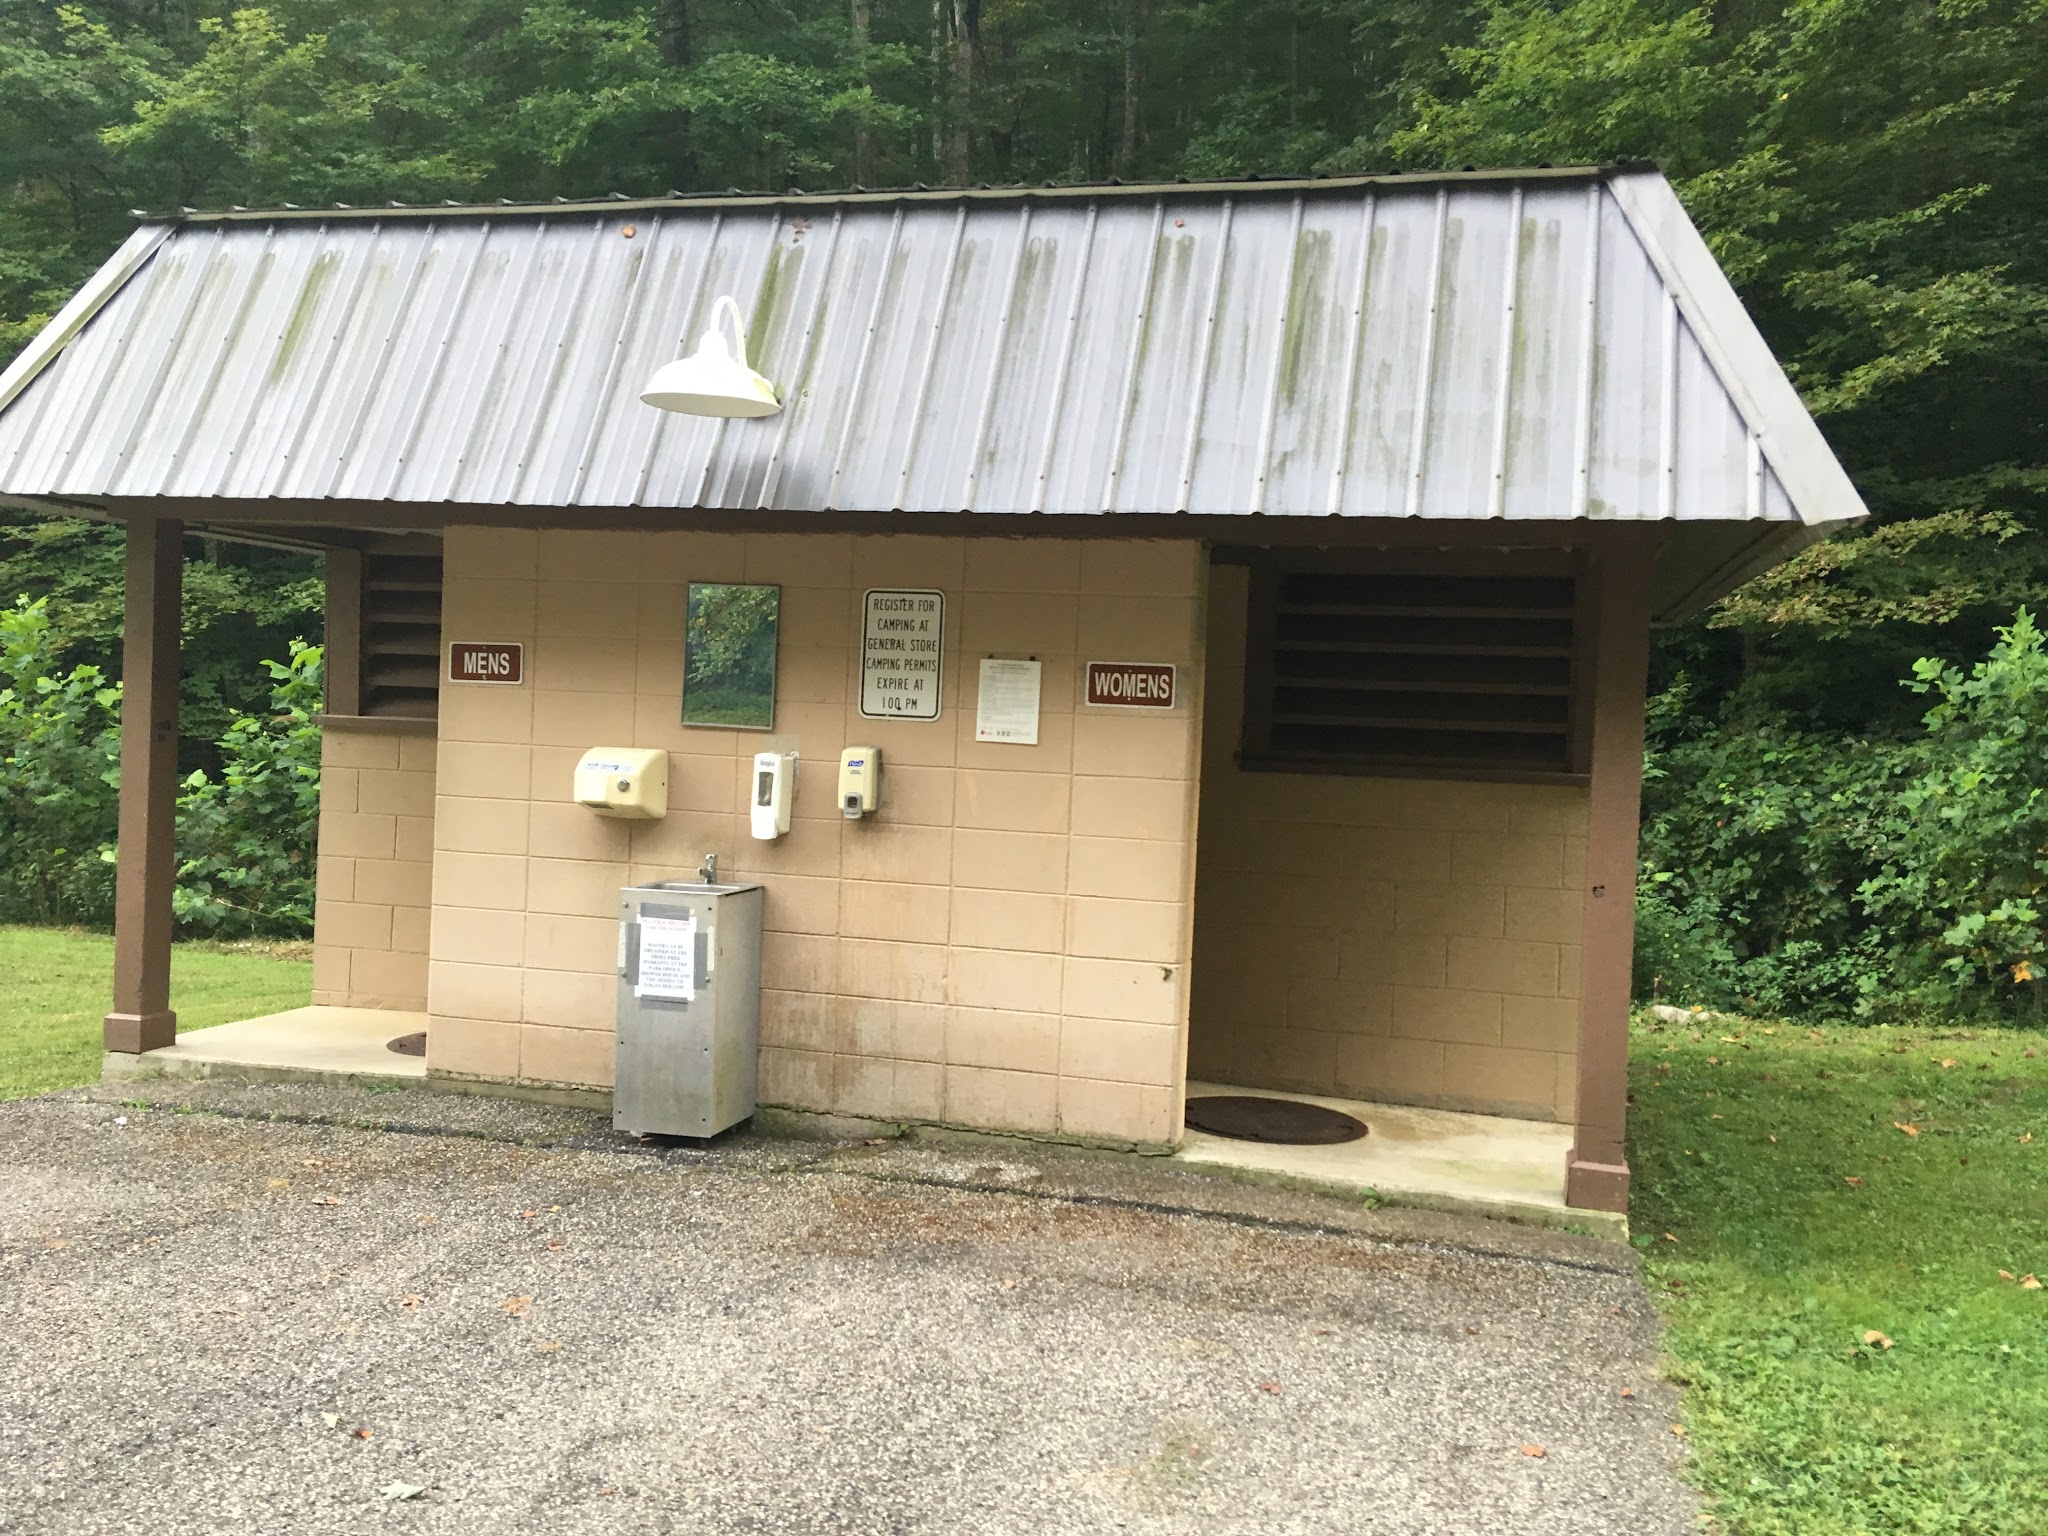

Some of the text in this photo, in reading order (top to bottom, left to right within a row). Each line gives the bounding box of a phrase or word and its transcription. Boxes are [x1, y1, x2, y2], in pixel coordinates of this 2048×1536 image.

[873, 598, 935, 612] REGISTER FOR
[877, 618, 929, 632] CAMPING AT
[867, 638, 937, 652] GENERAL STORE
[463, 652, 510, 675] MENS
[866, 657, 937, 672] CAMPING PERMITS
[876, 677, 924, 691] EXPIRE AT
[1094, 672, 1170, 699] WOMENS
[905, 698, 918, 710] PM
